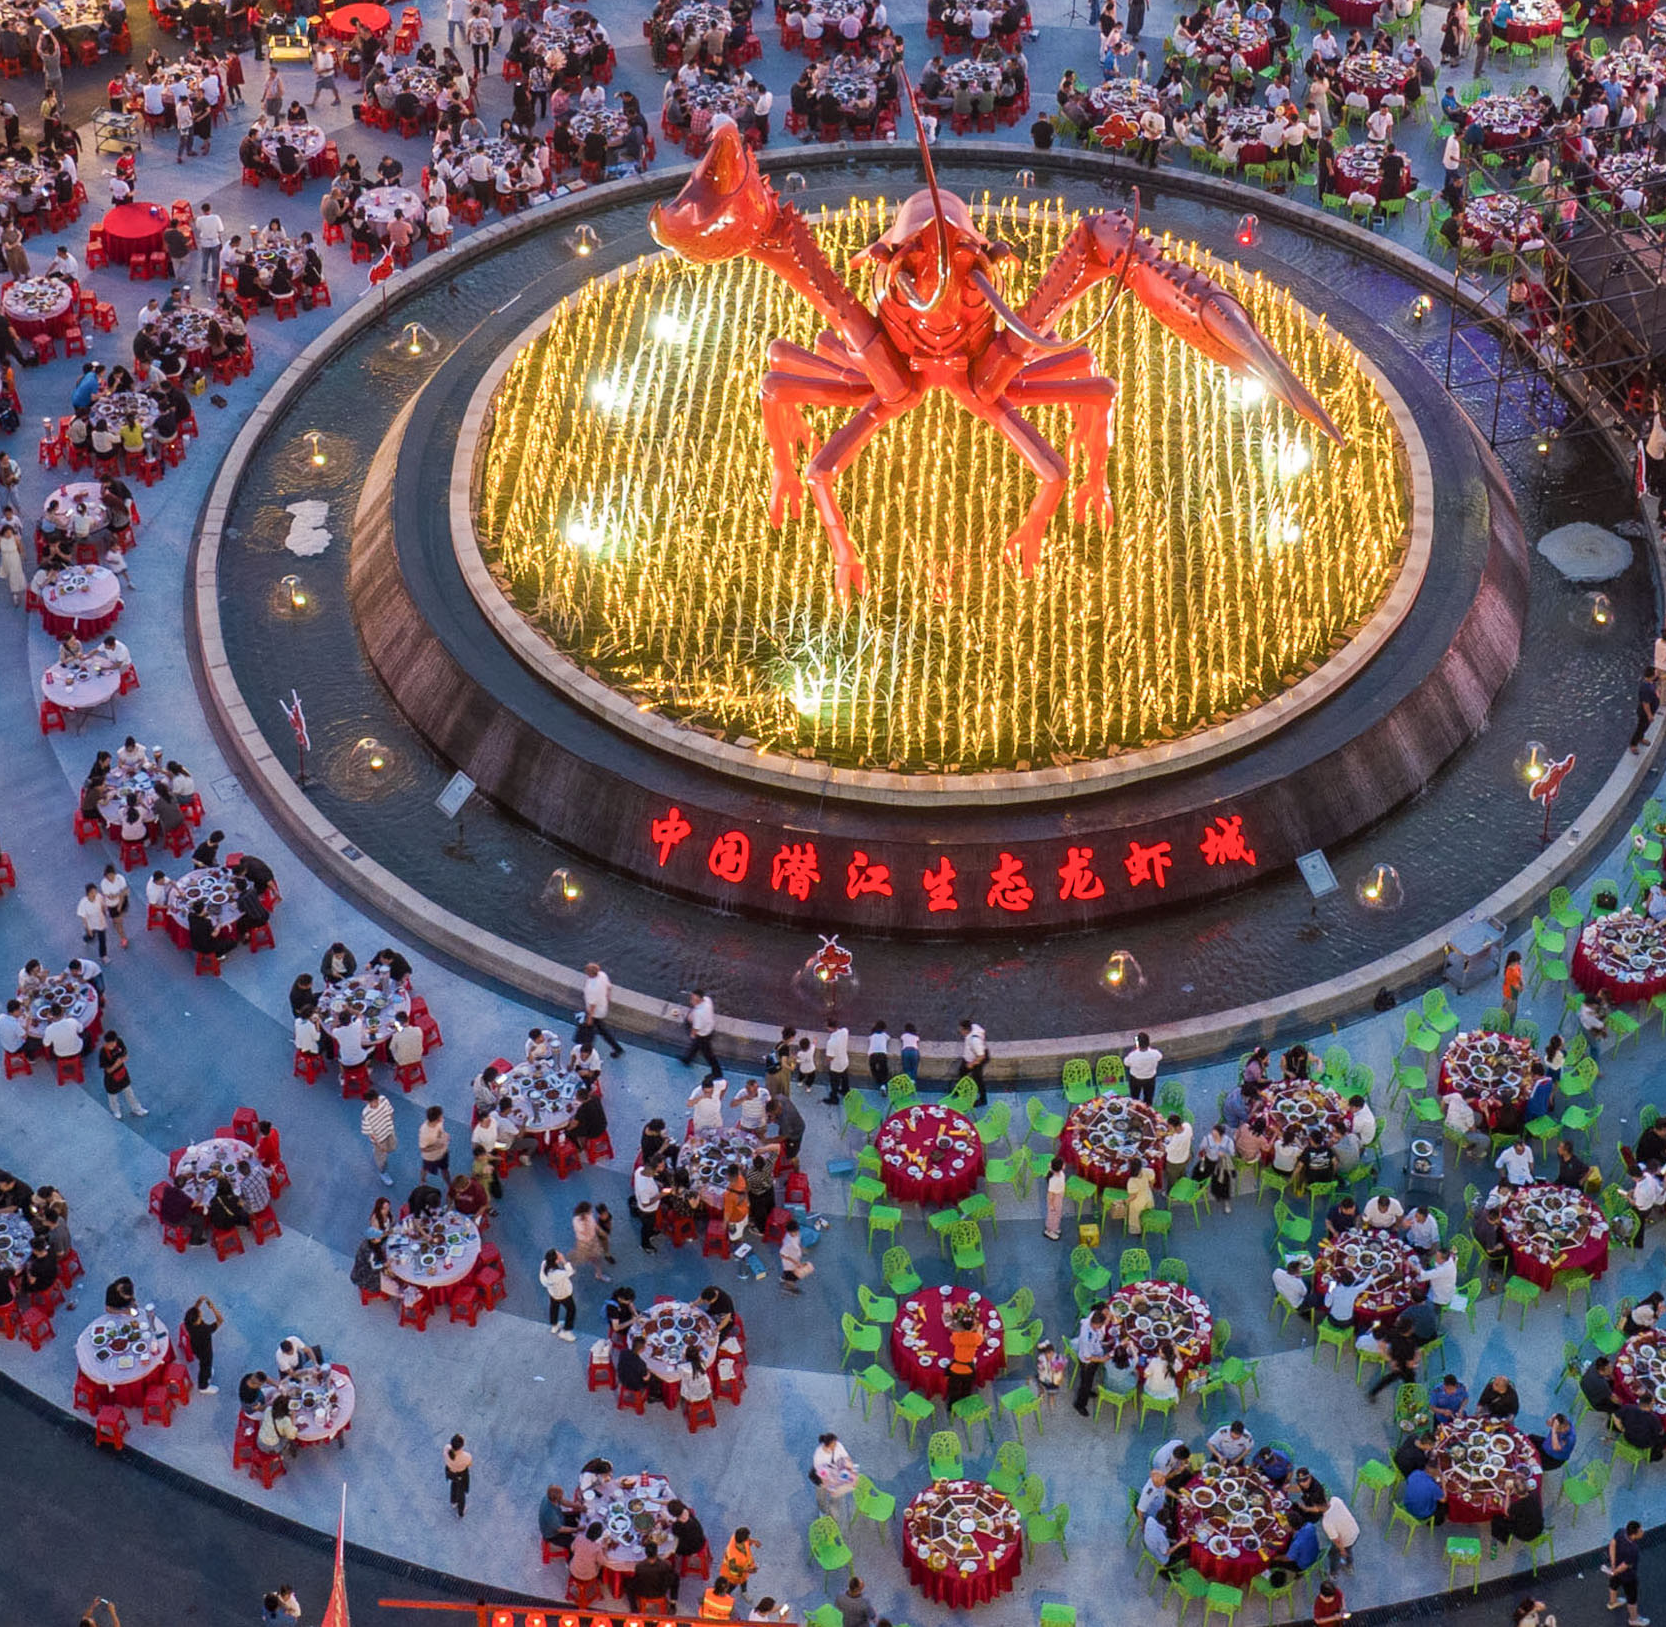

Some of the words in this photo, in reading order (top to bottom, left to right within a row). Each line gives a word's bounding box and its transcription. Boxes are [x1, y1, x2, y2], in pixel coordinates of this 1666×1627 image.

[652, 807, 1256, 911] 中国潜江生态龙虾城
